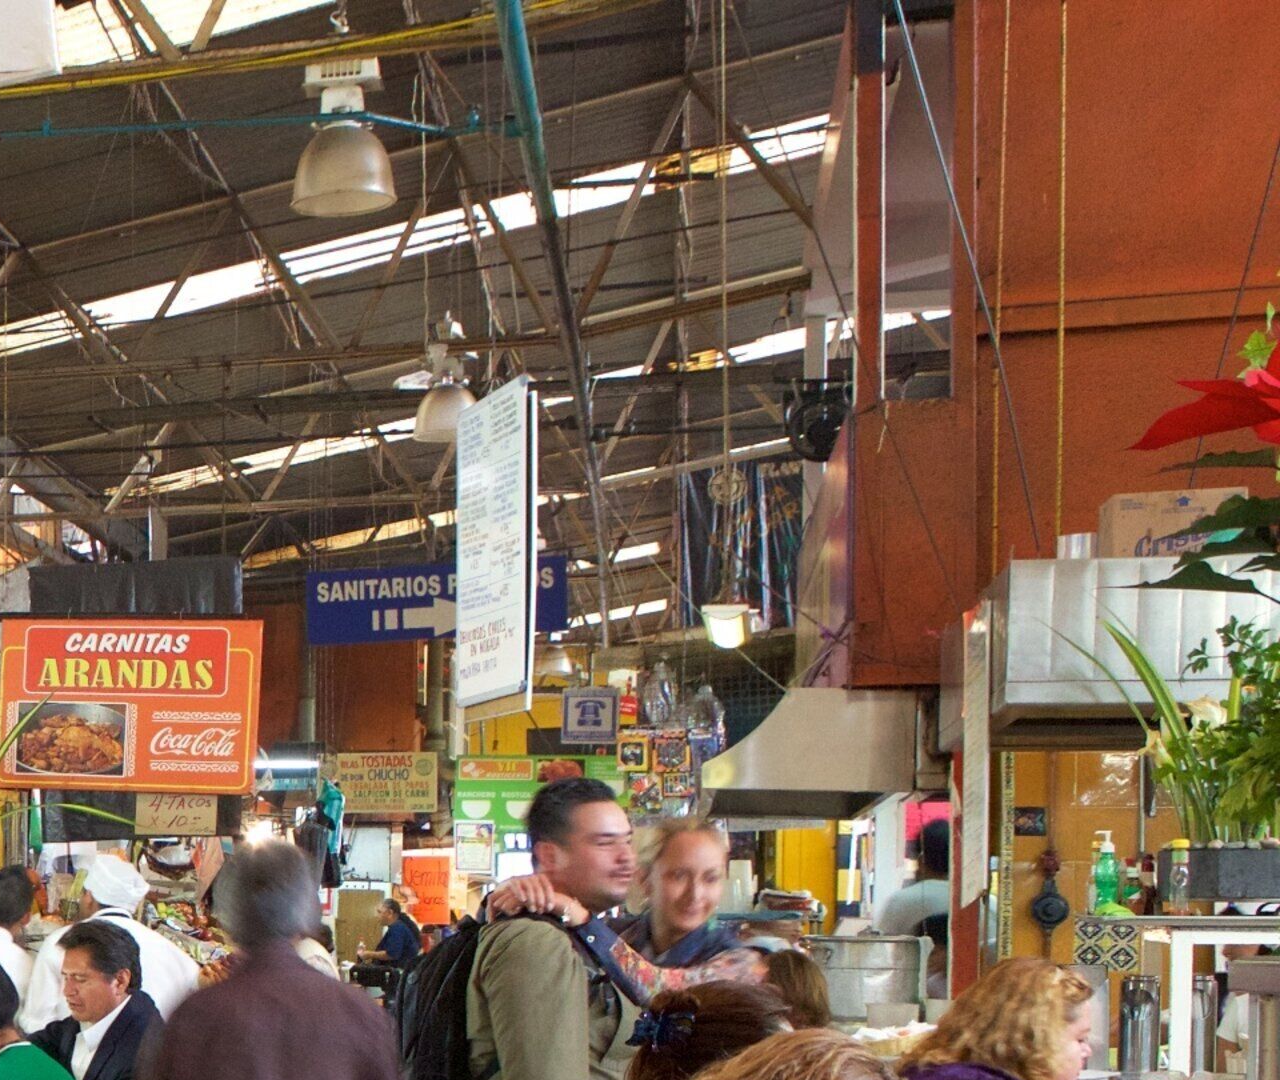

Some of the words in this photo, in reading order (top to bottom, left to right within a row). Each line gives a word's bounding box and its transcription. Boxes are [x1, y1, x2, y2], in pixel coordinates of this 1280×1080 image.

[317, 575, 441, 603] SANITARIOS
[65, 633, 190, 654] CARNITAS
[38, 658, 213, 690] ARANDAS
[149, 727, 241, 757] Coca-Cola
[360, 755, 413, 768] TOSTADAS
[367, 768, 410, 781] CHUCHO
